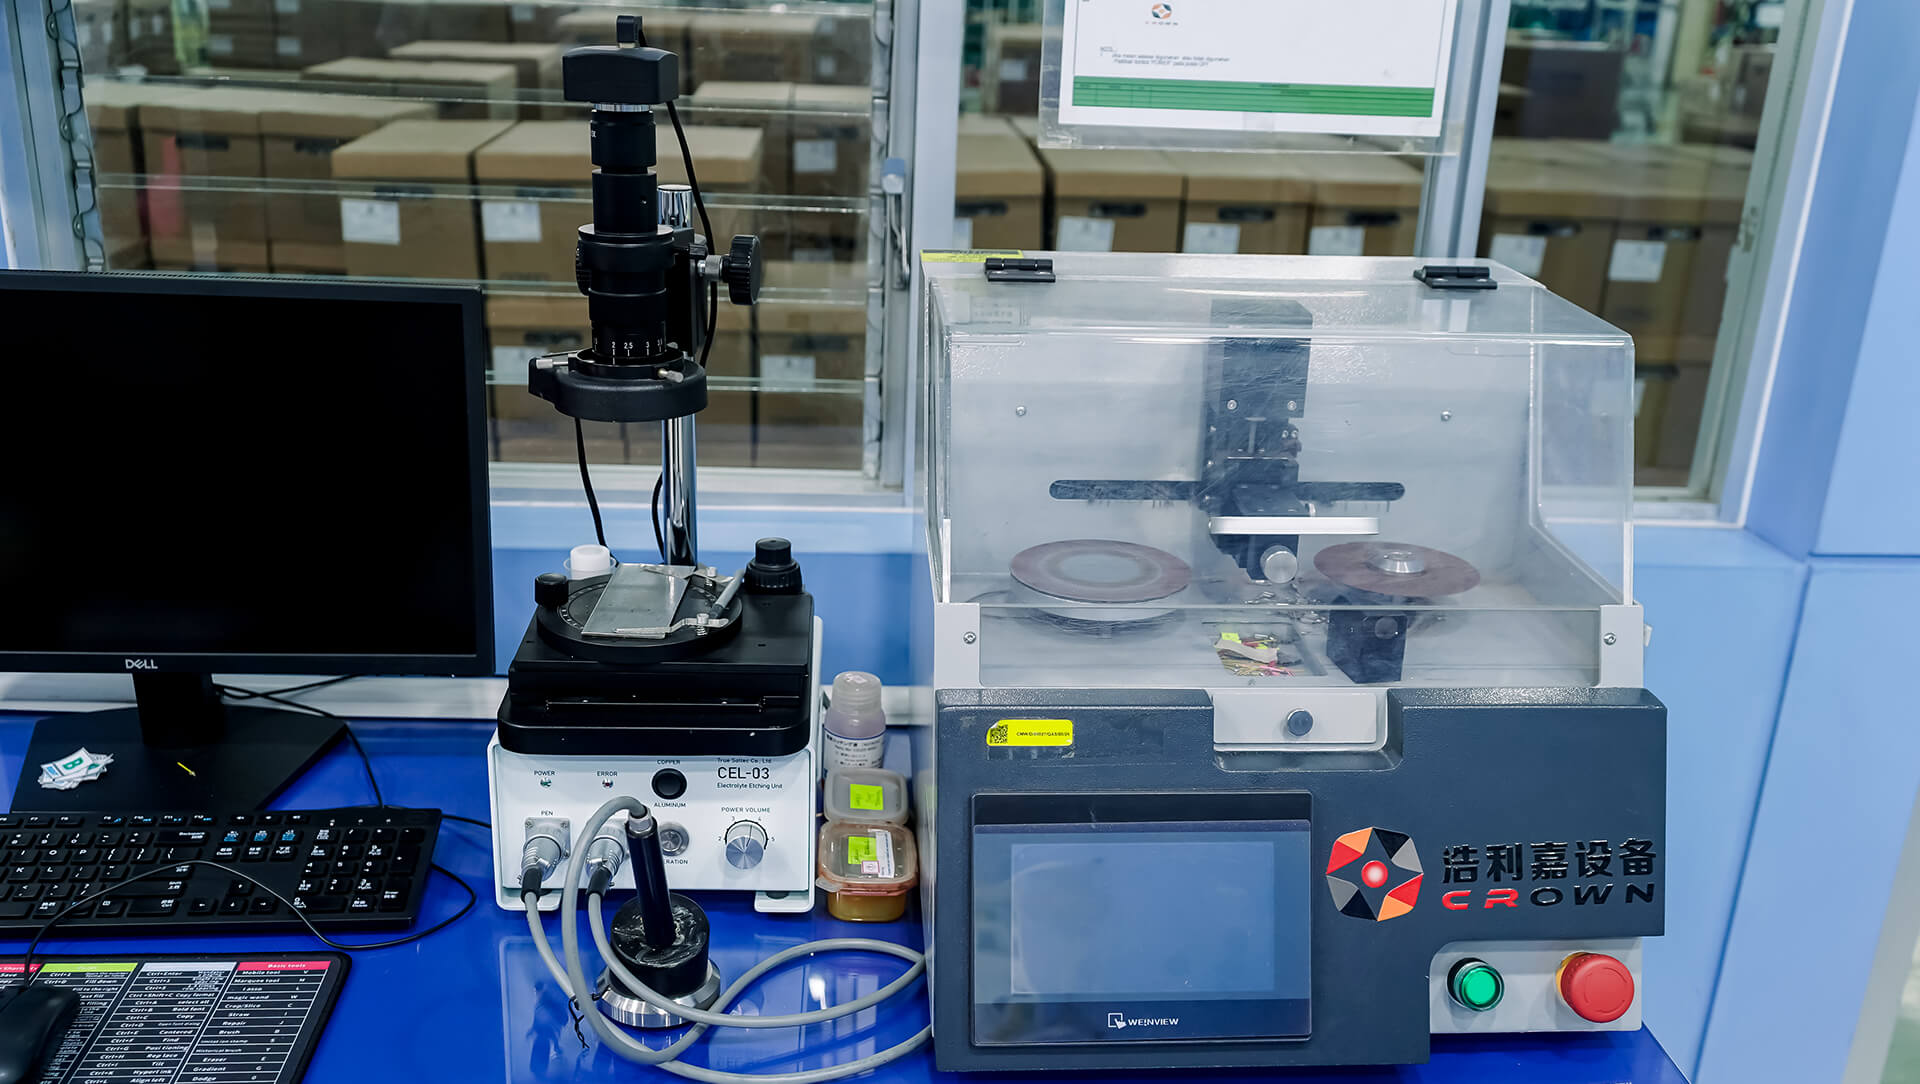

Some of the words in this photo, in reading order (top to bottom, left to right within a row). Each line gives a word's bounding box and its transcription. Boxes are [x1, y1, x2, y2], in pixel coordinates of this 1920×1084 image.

[125, 659, 158, 669] DELL
[62, 757, 84, 770] B
[717, 767, 769, 779] CEL-03
[1442, 837, 1656, 883] 浩利嘉设备
[1441, 883, 1655, 911] CROWN
